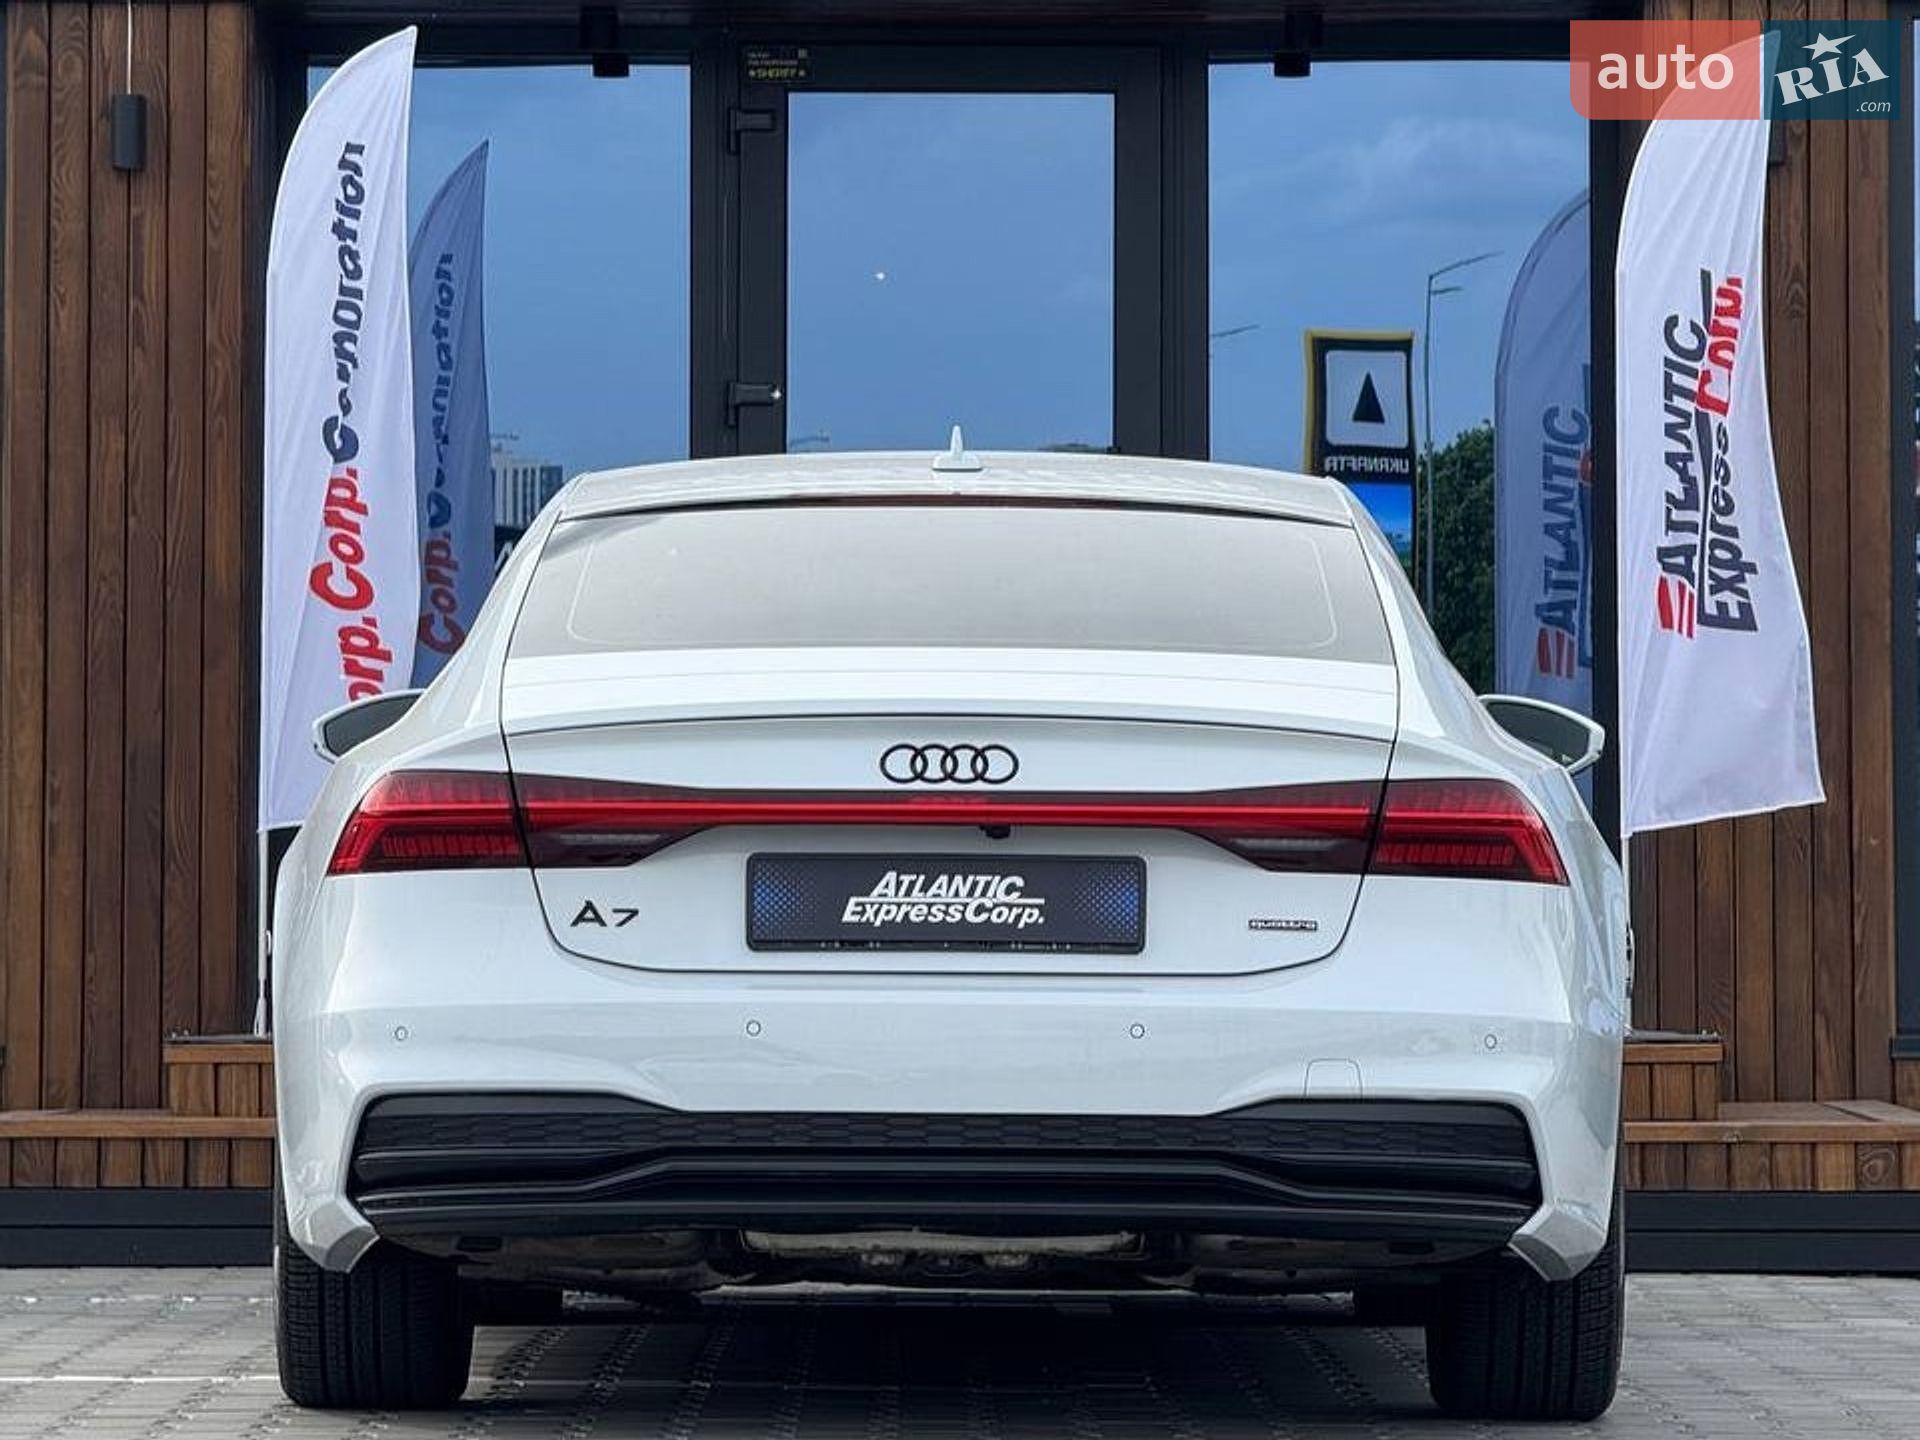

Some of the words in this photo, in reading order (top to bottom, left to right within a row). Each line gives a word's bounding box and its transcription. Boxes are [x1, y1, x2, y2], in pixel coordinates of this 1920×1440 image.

[1535, 405, 1590, 636] ATLANTIC
[1656, 314, 1707, 589] ATLANTIC
[309, 467, 375, 611] Corp.
[570, 900, 640, 927] A7
[868, 871, 1025, 900] ATLANTIC
